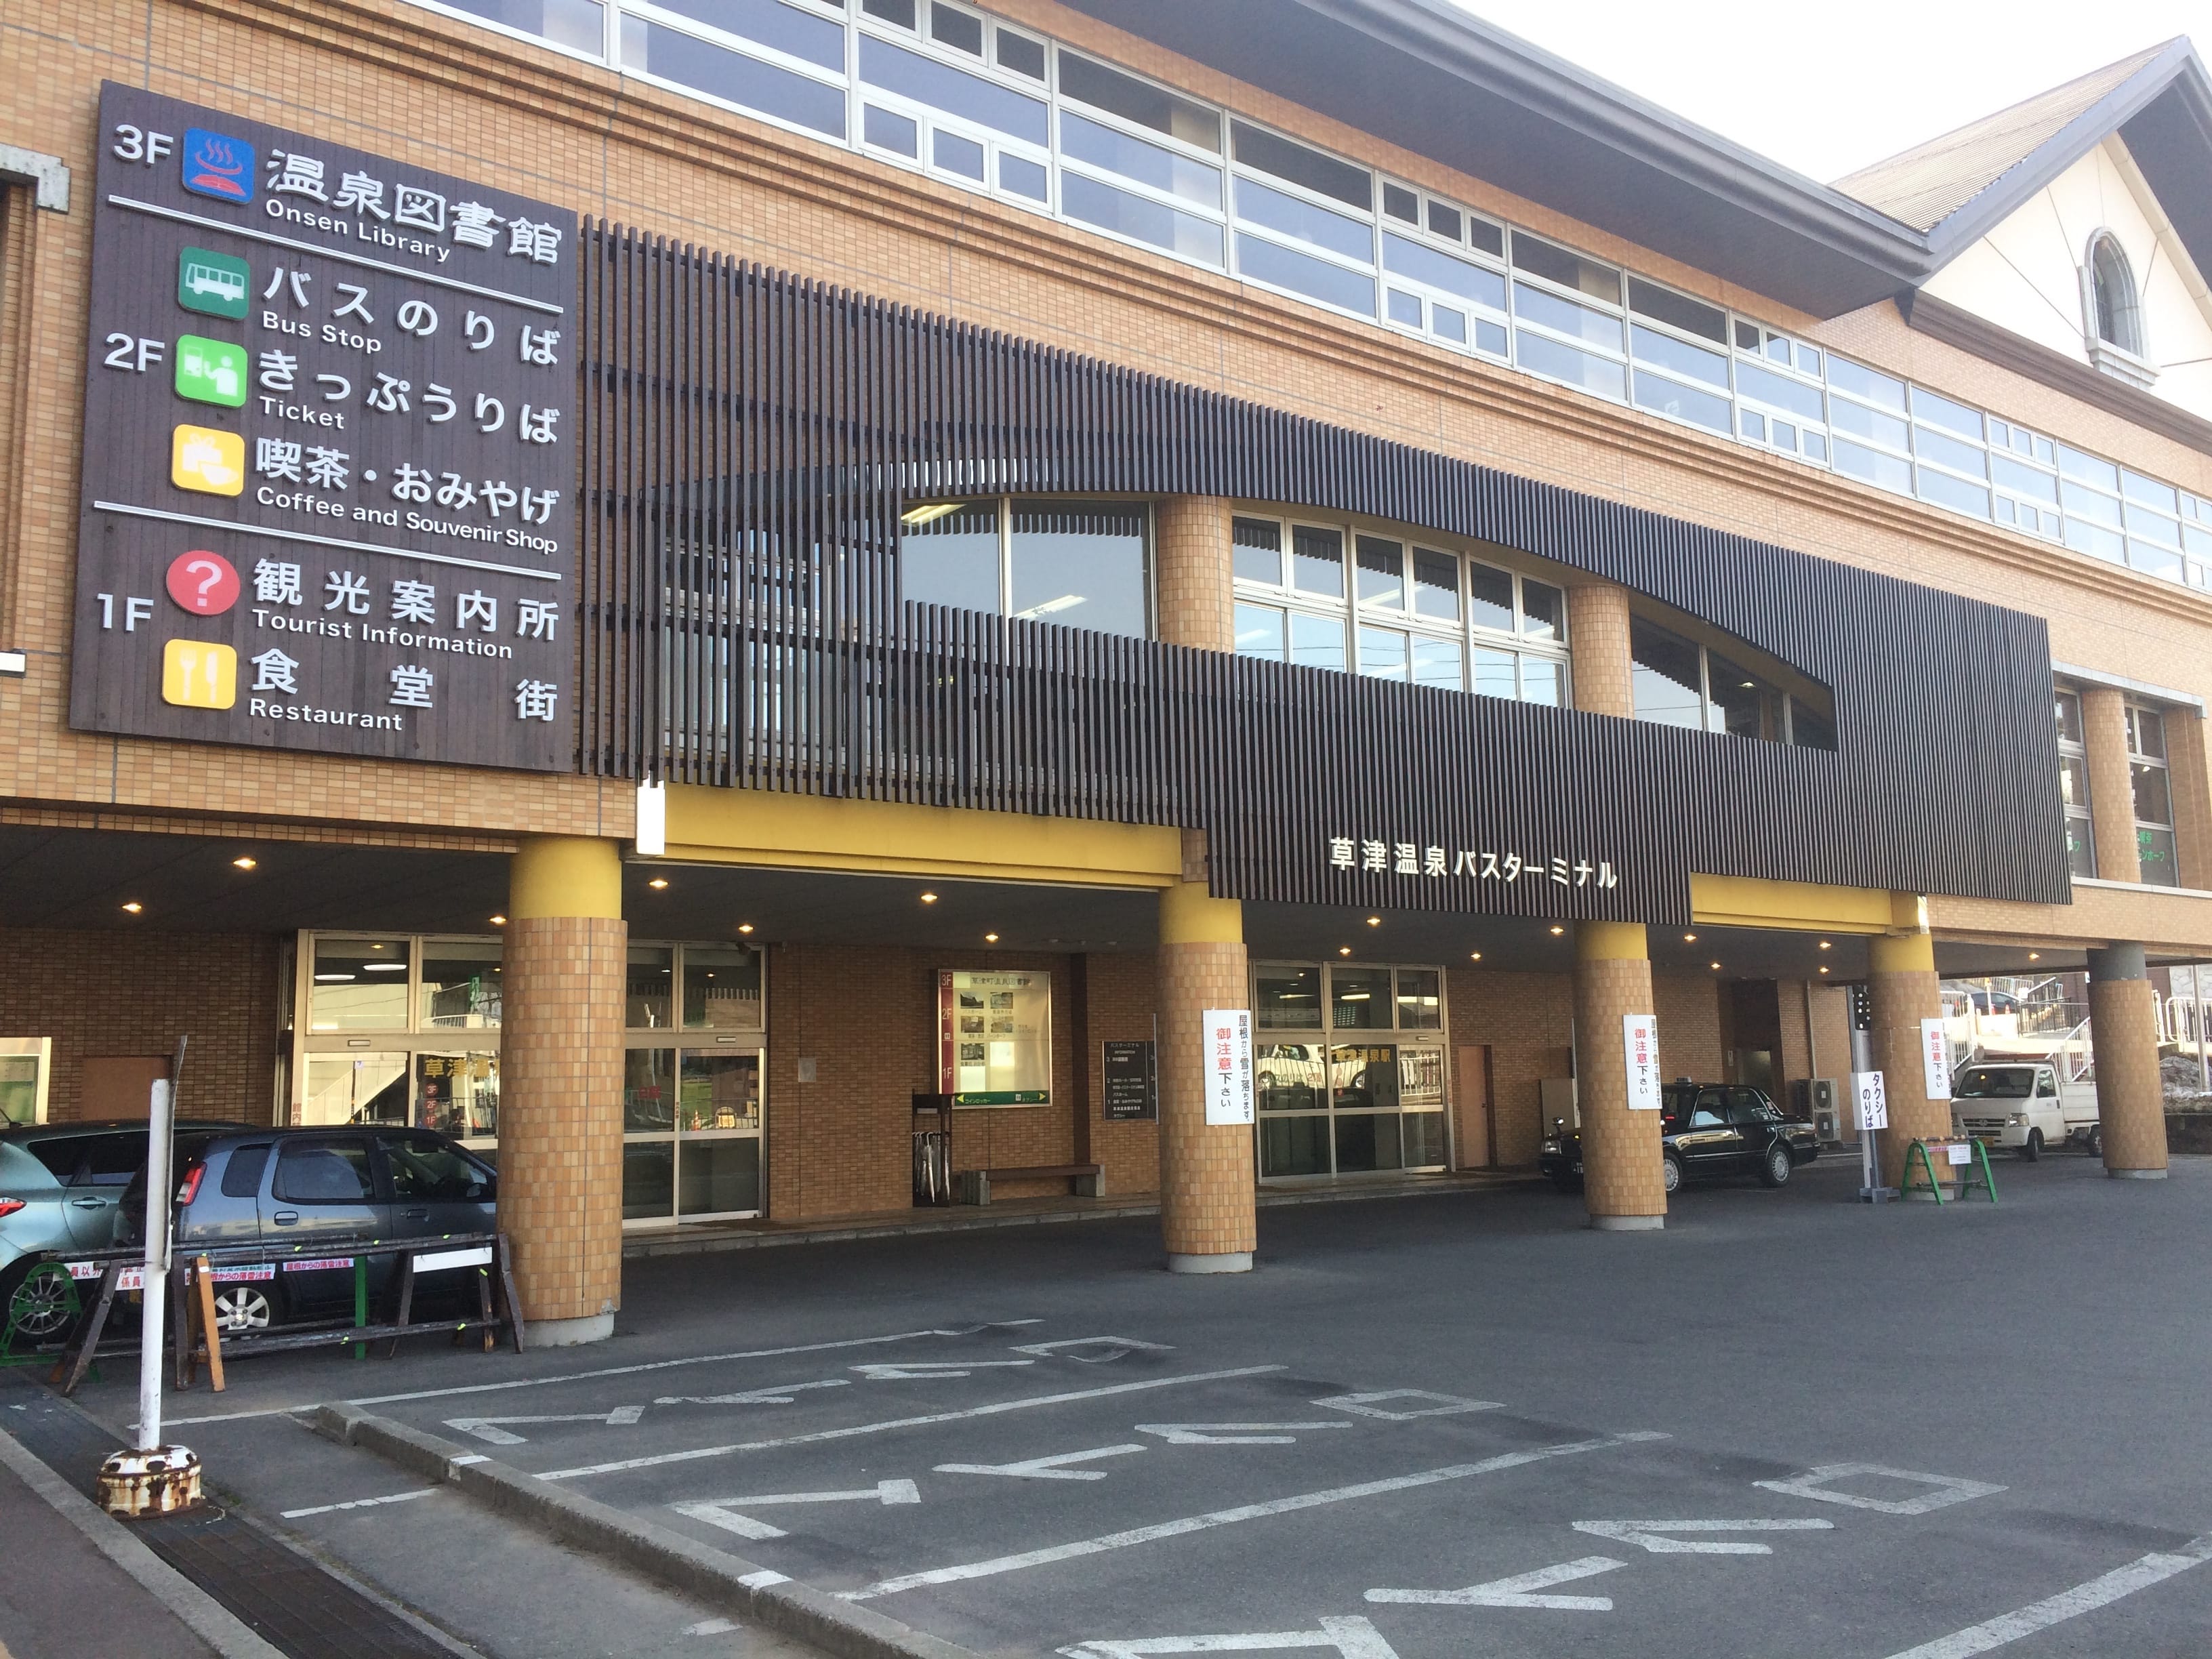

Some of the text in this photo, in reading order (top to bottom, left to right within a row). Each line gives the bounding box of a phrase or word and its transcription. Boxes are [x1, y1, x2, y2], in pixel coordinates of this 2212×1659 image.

[112, 124, 173, 166] 3F
[266, 149, 562, 265] 温泉図書館
[266, 199, 450, 263] Onsen Library
[262, 310, 382, 354] Bus Stop
[264, 266, 560, 367] バスのりば
[104, 332, 165, 372] 2F
[258, 349, 560, 444] きっぷうりば
[259, 396, 345, 430] Ticket
[255, 437, 560, 525] 喫茶・おみやげ
[257, 486, 558, 554] Coffee and Souvenir Shop
[96, 593, 155, 632] 1F
[253, 558, 559, 641] 観光案内所
[252, 609, 513, 659] Tourist Information
[251, 649, 558, 722] 食堂街
[250, 699, 403, 731] Restaurant
[1330, 837, 1617, 889] 草津温泉バスターミナル
[942, 974, 951, 986] 3F
[942, 1008, 951, 1020] 2F
[943, 1067, 952, 1079] 1F
[1216, 1027, 1232, 1107] 御注意下さい
[1635, 1029, 1648, 1094] 御注意下さい
[427, 1086, 436, 1094] 3F
[1862, 1088, 1873, 1128] のりば
[1873, 1073, 1883, 1127] タクシー
[426, 1115, 436, 1124] 1F
